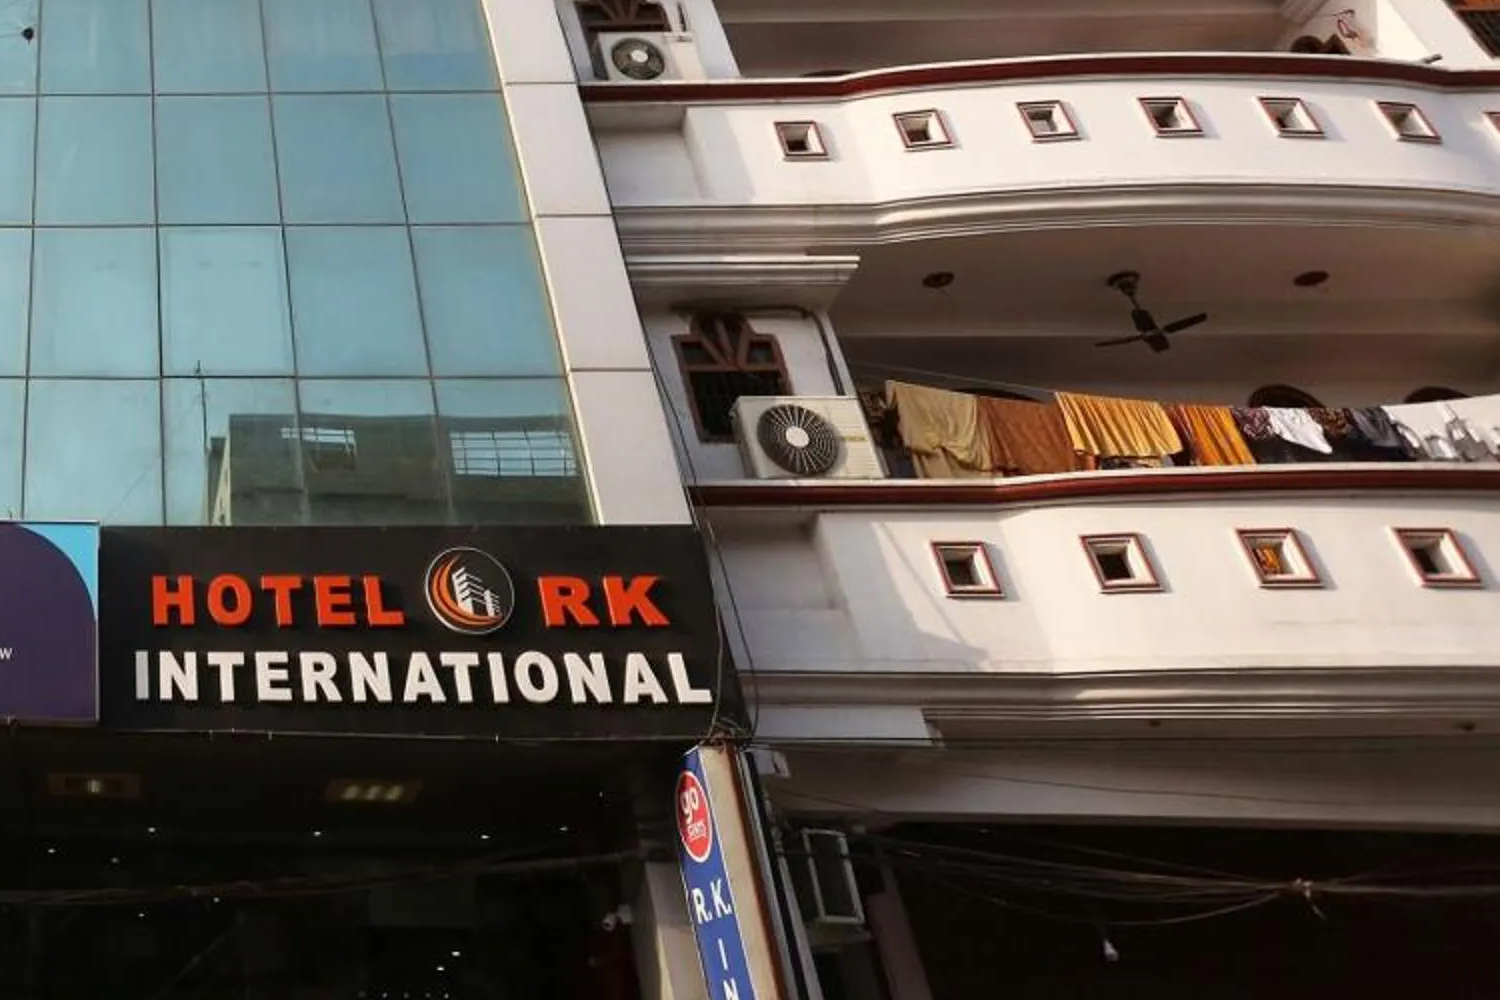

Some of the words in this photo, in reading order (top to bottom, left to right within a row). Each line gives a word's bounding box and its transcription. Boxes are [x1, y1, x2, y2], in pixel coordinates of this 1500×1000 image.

[151, 575, 405, 627] HOTEL
[537, 575, 670, 627] RK
[134, 650, 713, 705] INTERNATIONAL
